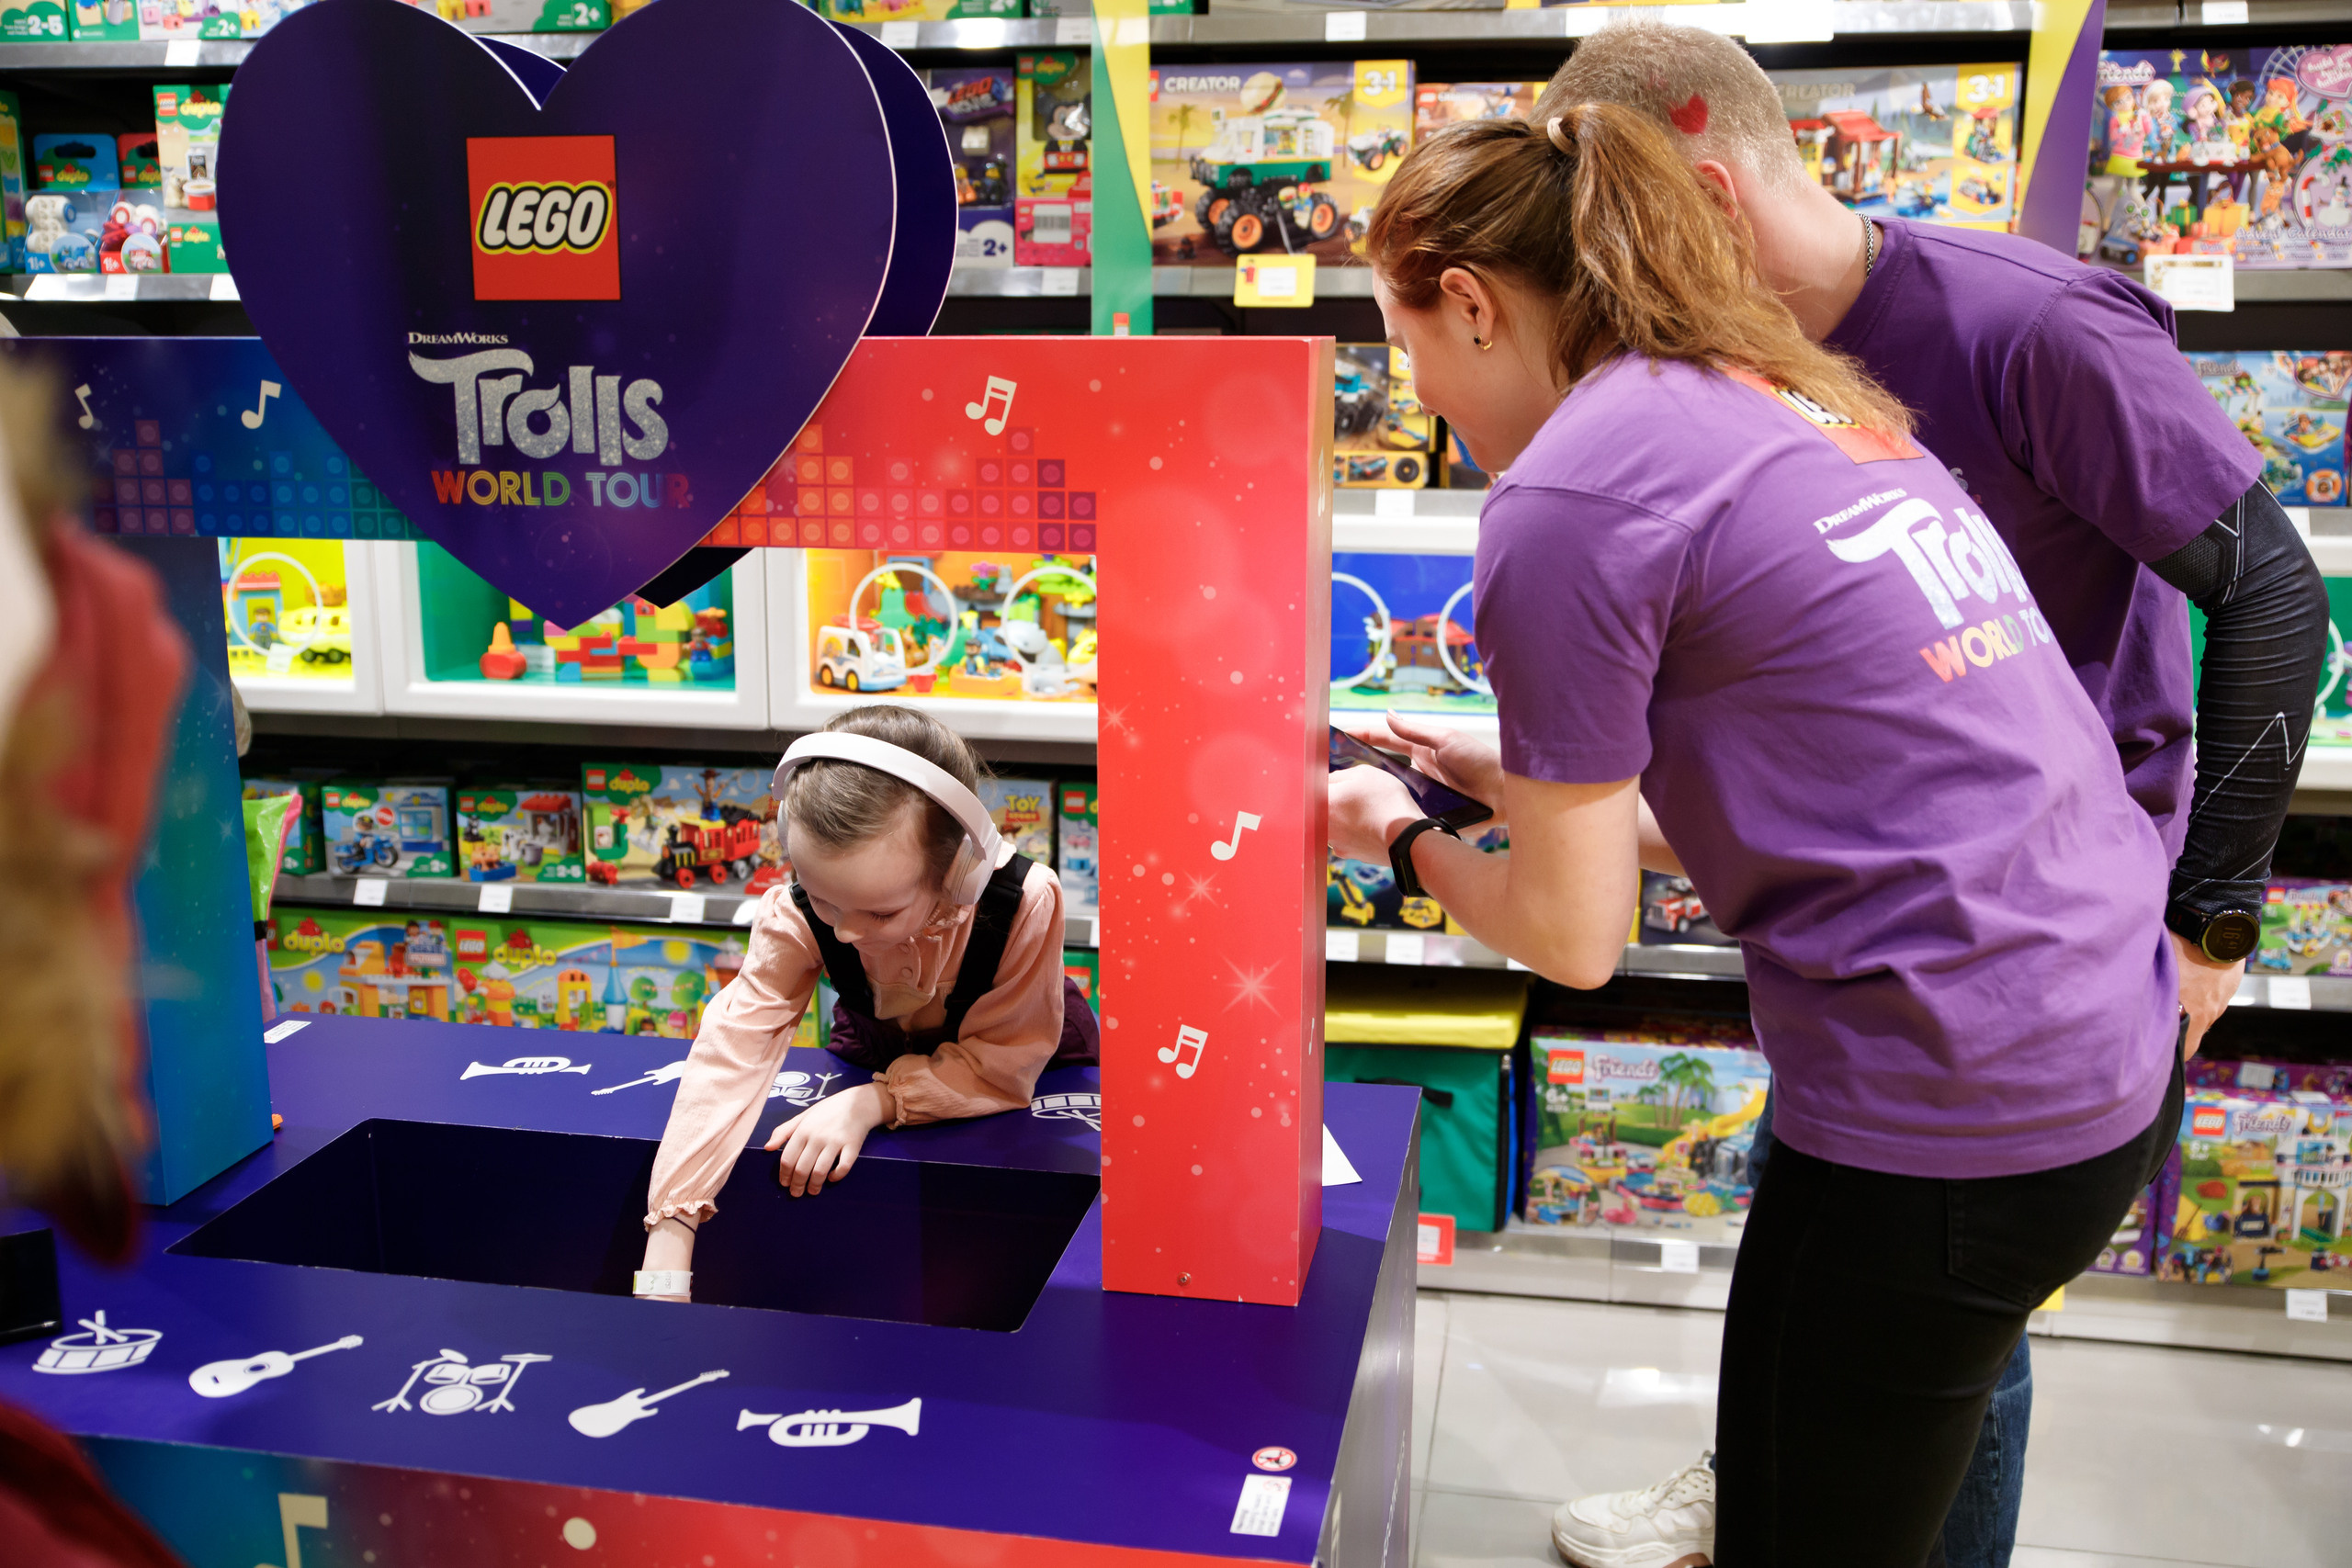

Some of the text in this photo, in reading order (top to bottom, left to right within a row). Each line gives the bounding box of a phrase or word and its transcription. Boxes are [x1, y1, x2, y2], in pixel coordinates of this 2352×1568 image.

[573, 3, 601, 26] 2+
[1164, 75, 1240, 93] CREATOR
[180, 98, 222, 118] duplo
[480, 184, 610, 251] LEGO
[983, 239, 1008, 257] 2+
[408, 348, 669, 467] Trolls
[431, 470, 691, 508] WORLD TOUR
[1918, 614, 2025, 683] WORLD
[609, 776, 650, 795] duplo
[1005, 795, 1041, 811] TOY
[283, 930, 345, 956] duplo
[492, 942, 558, 969] duplo
[1550, 1054, 1659, 1082] LEGO Friends
[2194, 1110, 2291, 1135] LEGO Friends
